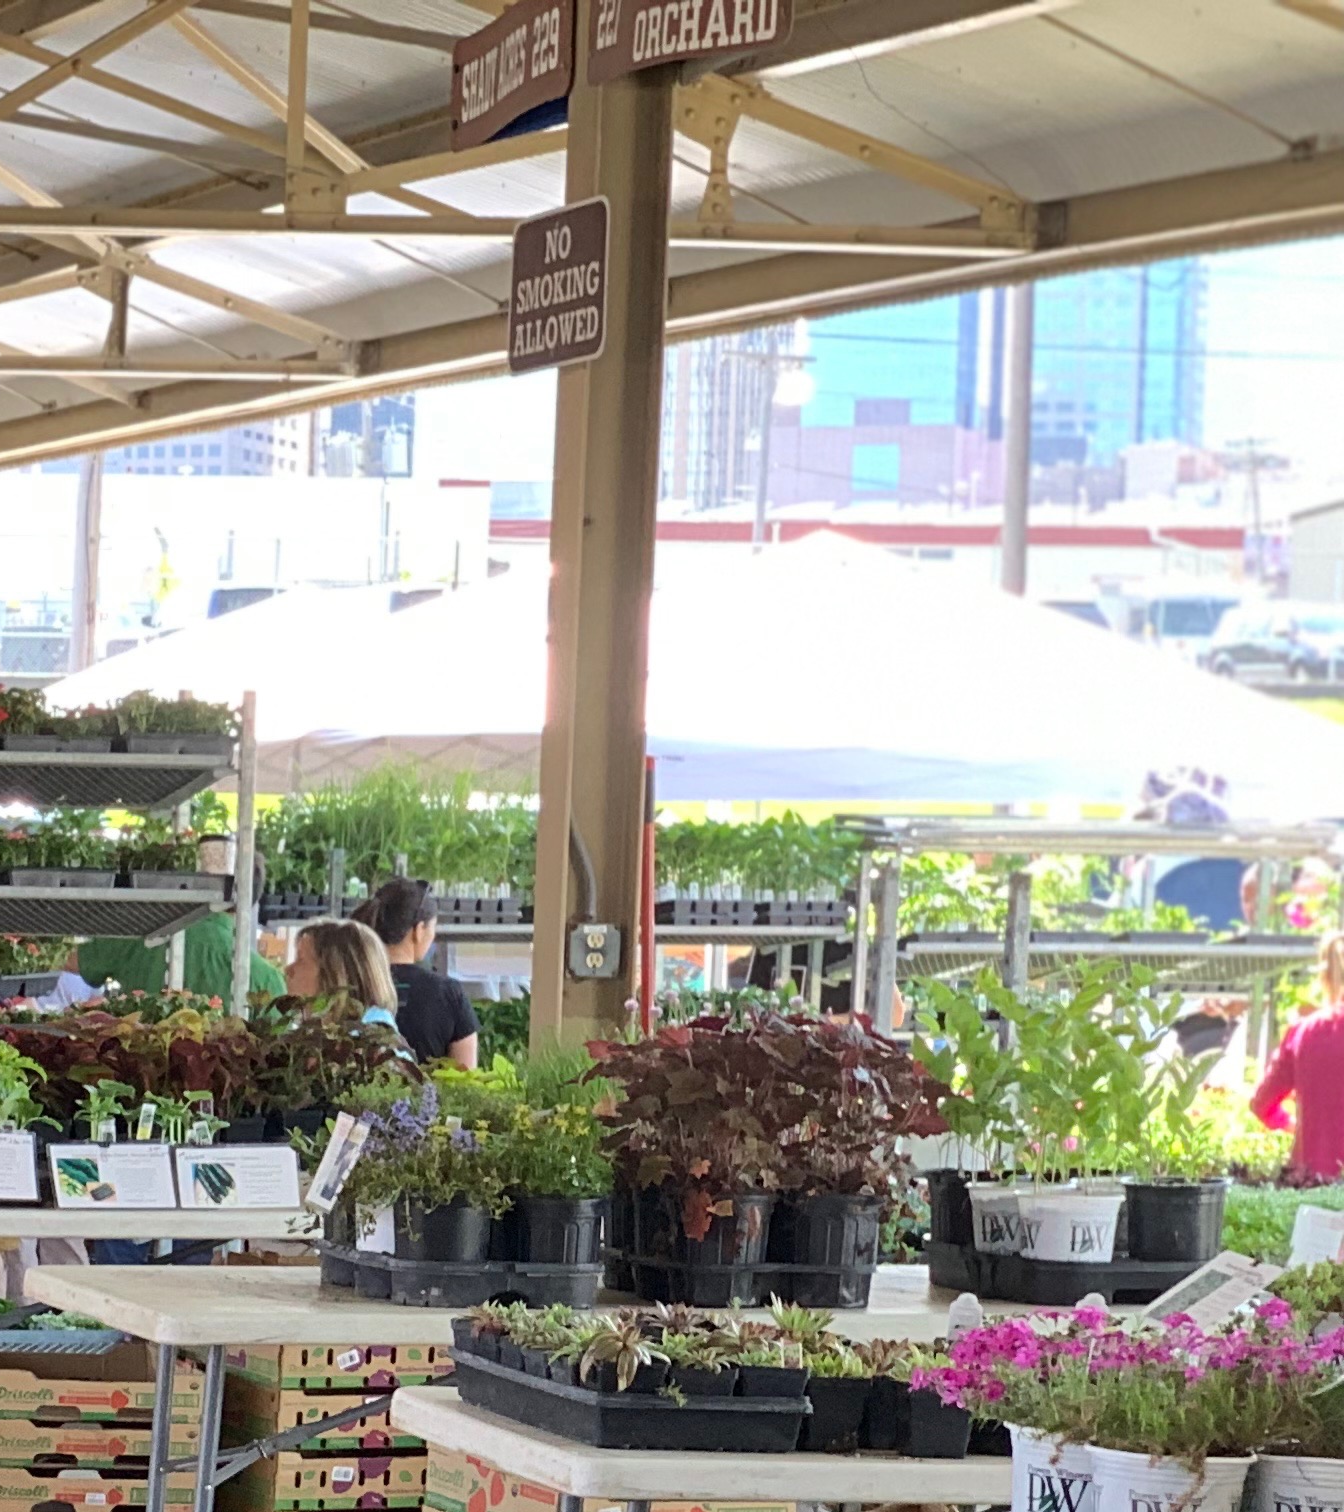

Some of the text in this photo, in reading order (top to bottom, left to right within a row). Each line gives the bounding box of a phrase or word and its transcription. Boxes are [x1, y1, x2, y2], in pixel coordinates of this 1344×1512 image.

[633, 0, 778, 62] ORCHARD
[461, 7, 560, 123] SHADY ACRES 229
[545, 224, 572, 264] NO
[516, 260, 600, 315] SMOKING
[513, 305, 599, 357] ALLOWED
